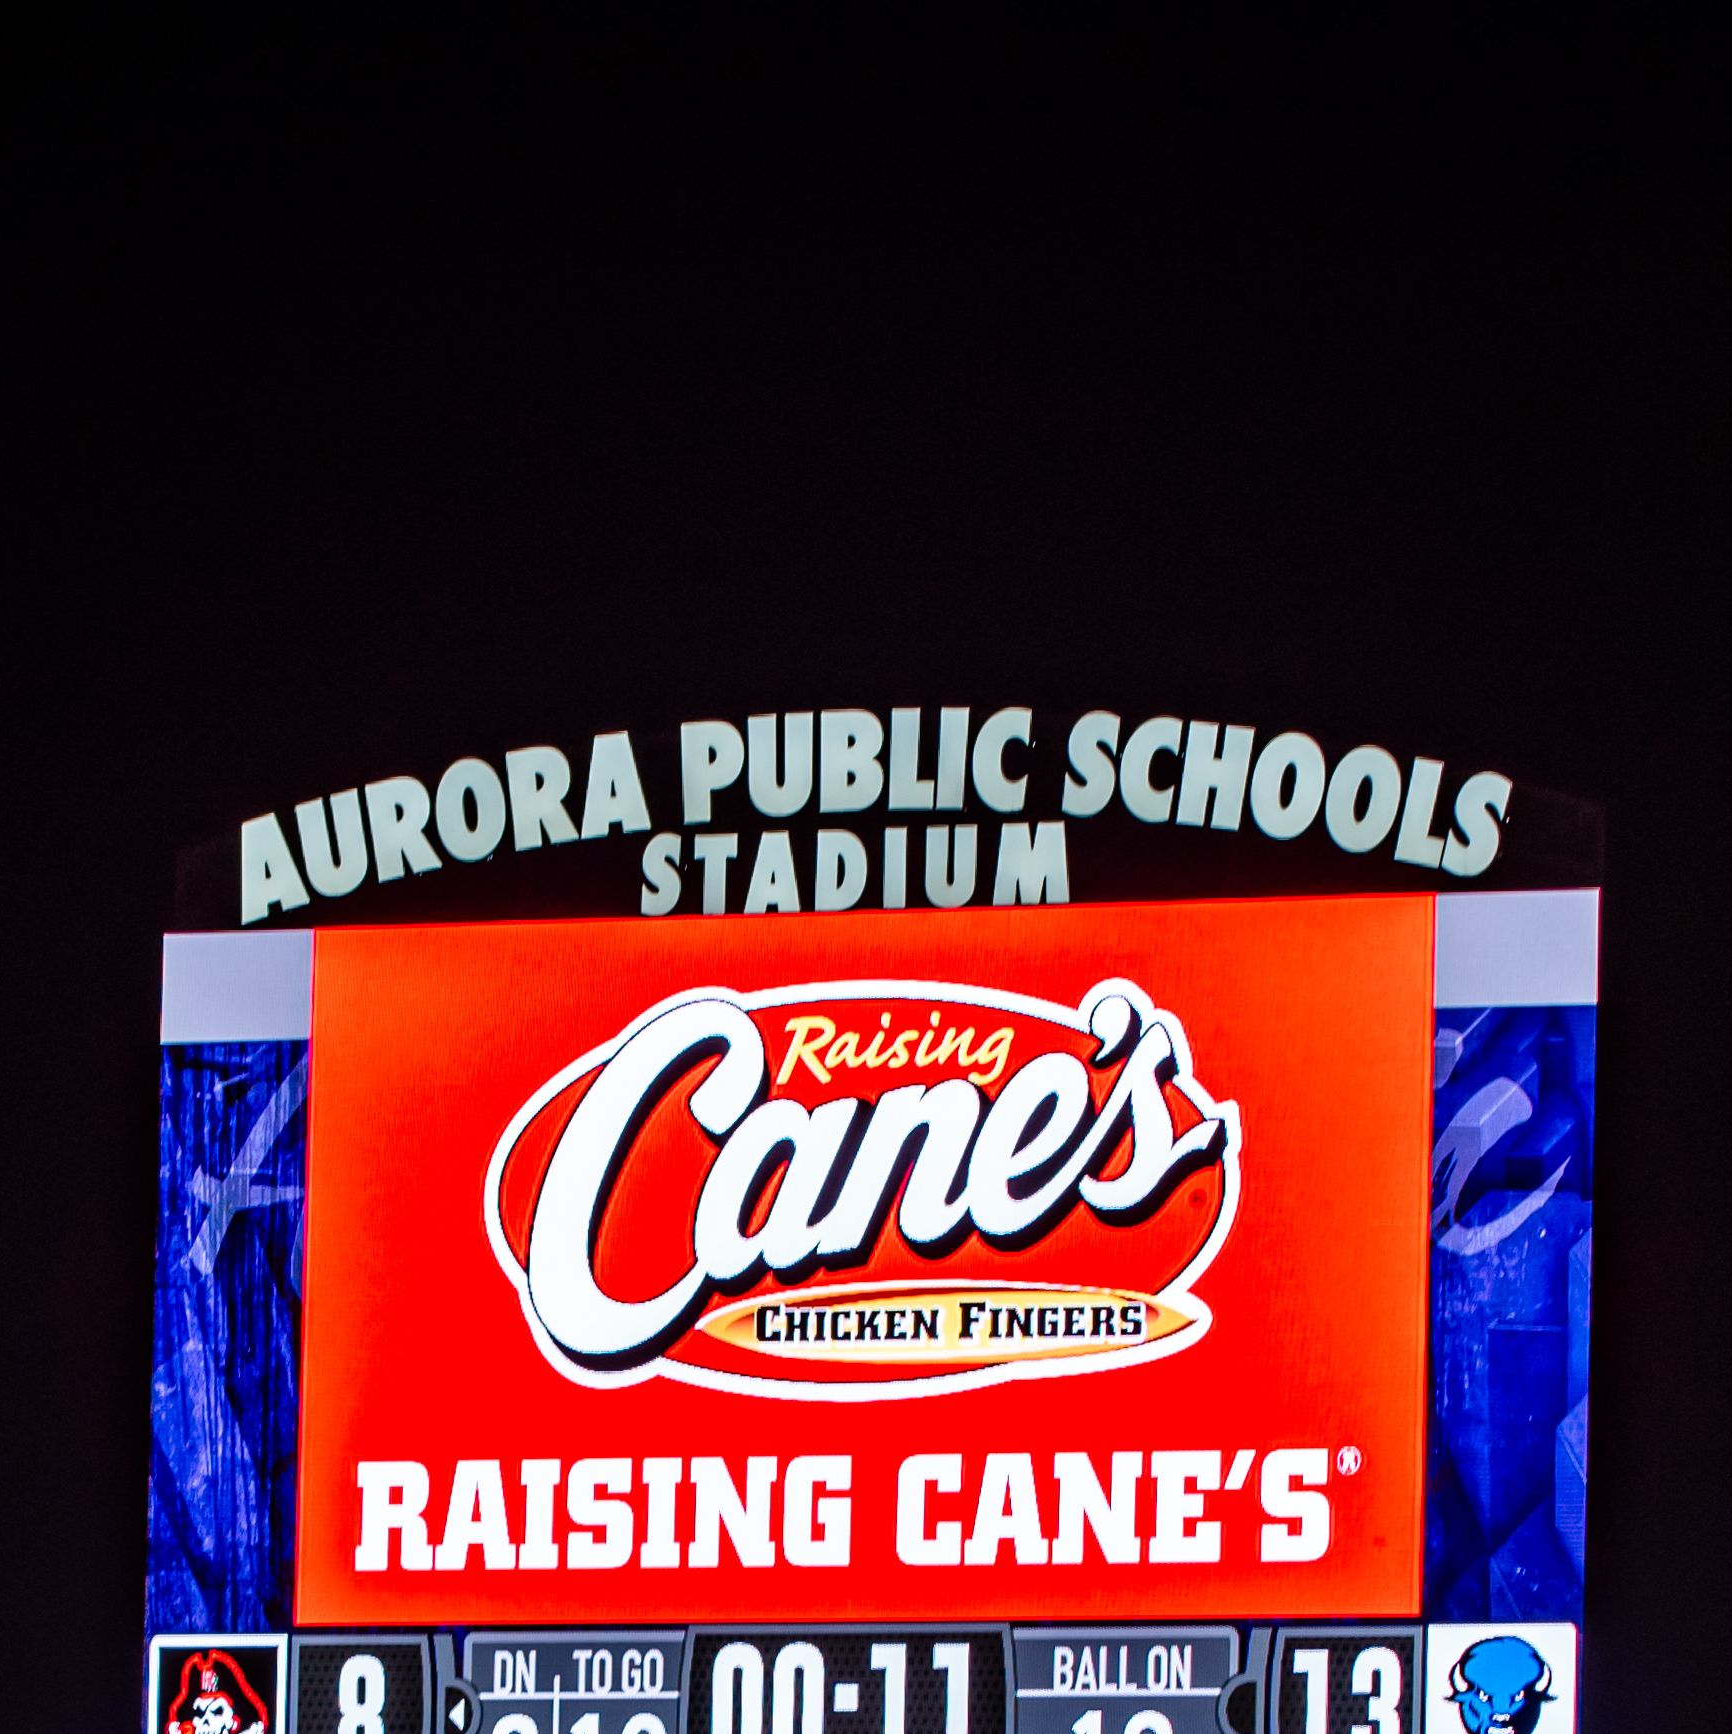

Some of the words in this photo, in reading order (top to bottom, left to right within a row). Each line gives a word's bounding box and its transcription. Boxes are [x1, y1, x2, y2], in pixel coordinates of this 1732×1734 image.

[241, 730, 652, 925] AURORA
[680, 706, 1033, 825] PUBLIC
[1061, 710, 1513, 877] SCHOOLS
[640, 821, 1070, 917] STADIUM
[777, 1010, 1015, 1085] Raising
[528, 993, 1227, 1362] Cane's
[354, 1454, 853, 1572] RAISING
[493, 1649, 537, 1694] DN
[572, 1648, 613, 1694] TO
[621, 1648, 665, 1693] GO
[1052, 1644, 1138, 1692] BALL
[1147, 1643, 1193, 1692] ON
